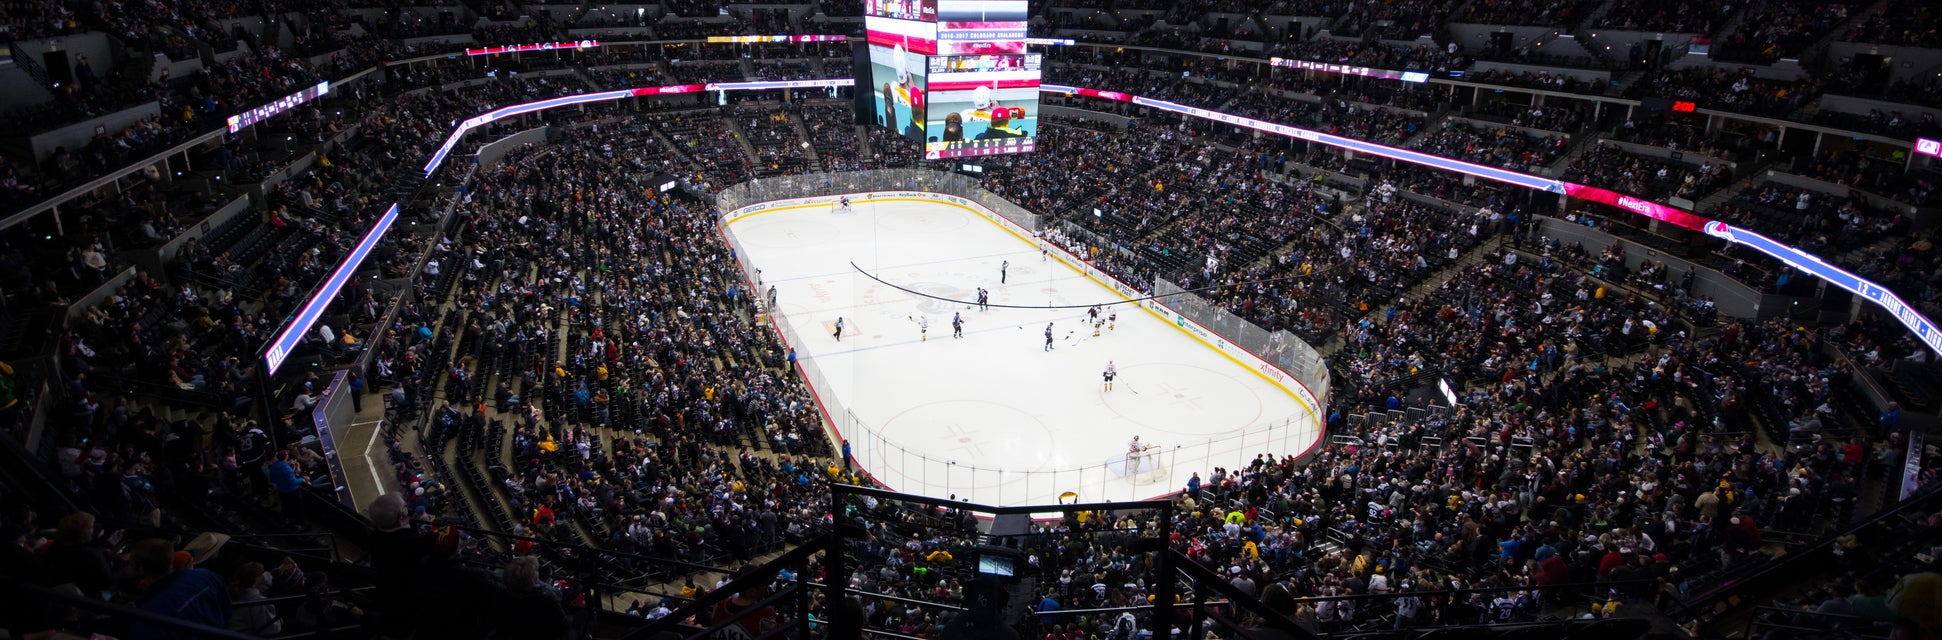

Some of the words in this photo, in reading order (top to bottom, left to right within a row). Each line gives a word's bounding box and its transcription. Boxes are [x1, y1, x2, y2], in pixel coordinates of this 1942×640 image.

[743, 204, 766, 214] GEICO
[1618, 197, 1650, 213] #NextEra
[1858, 281, 1869, 295] 12
[1260, 364, 1285, 382] xfinity
[1499, 608, 1511, 619] 29
